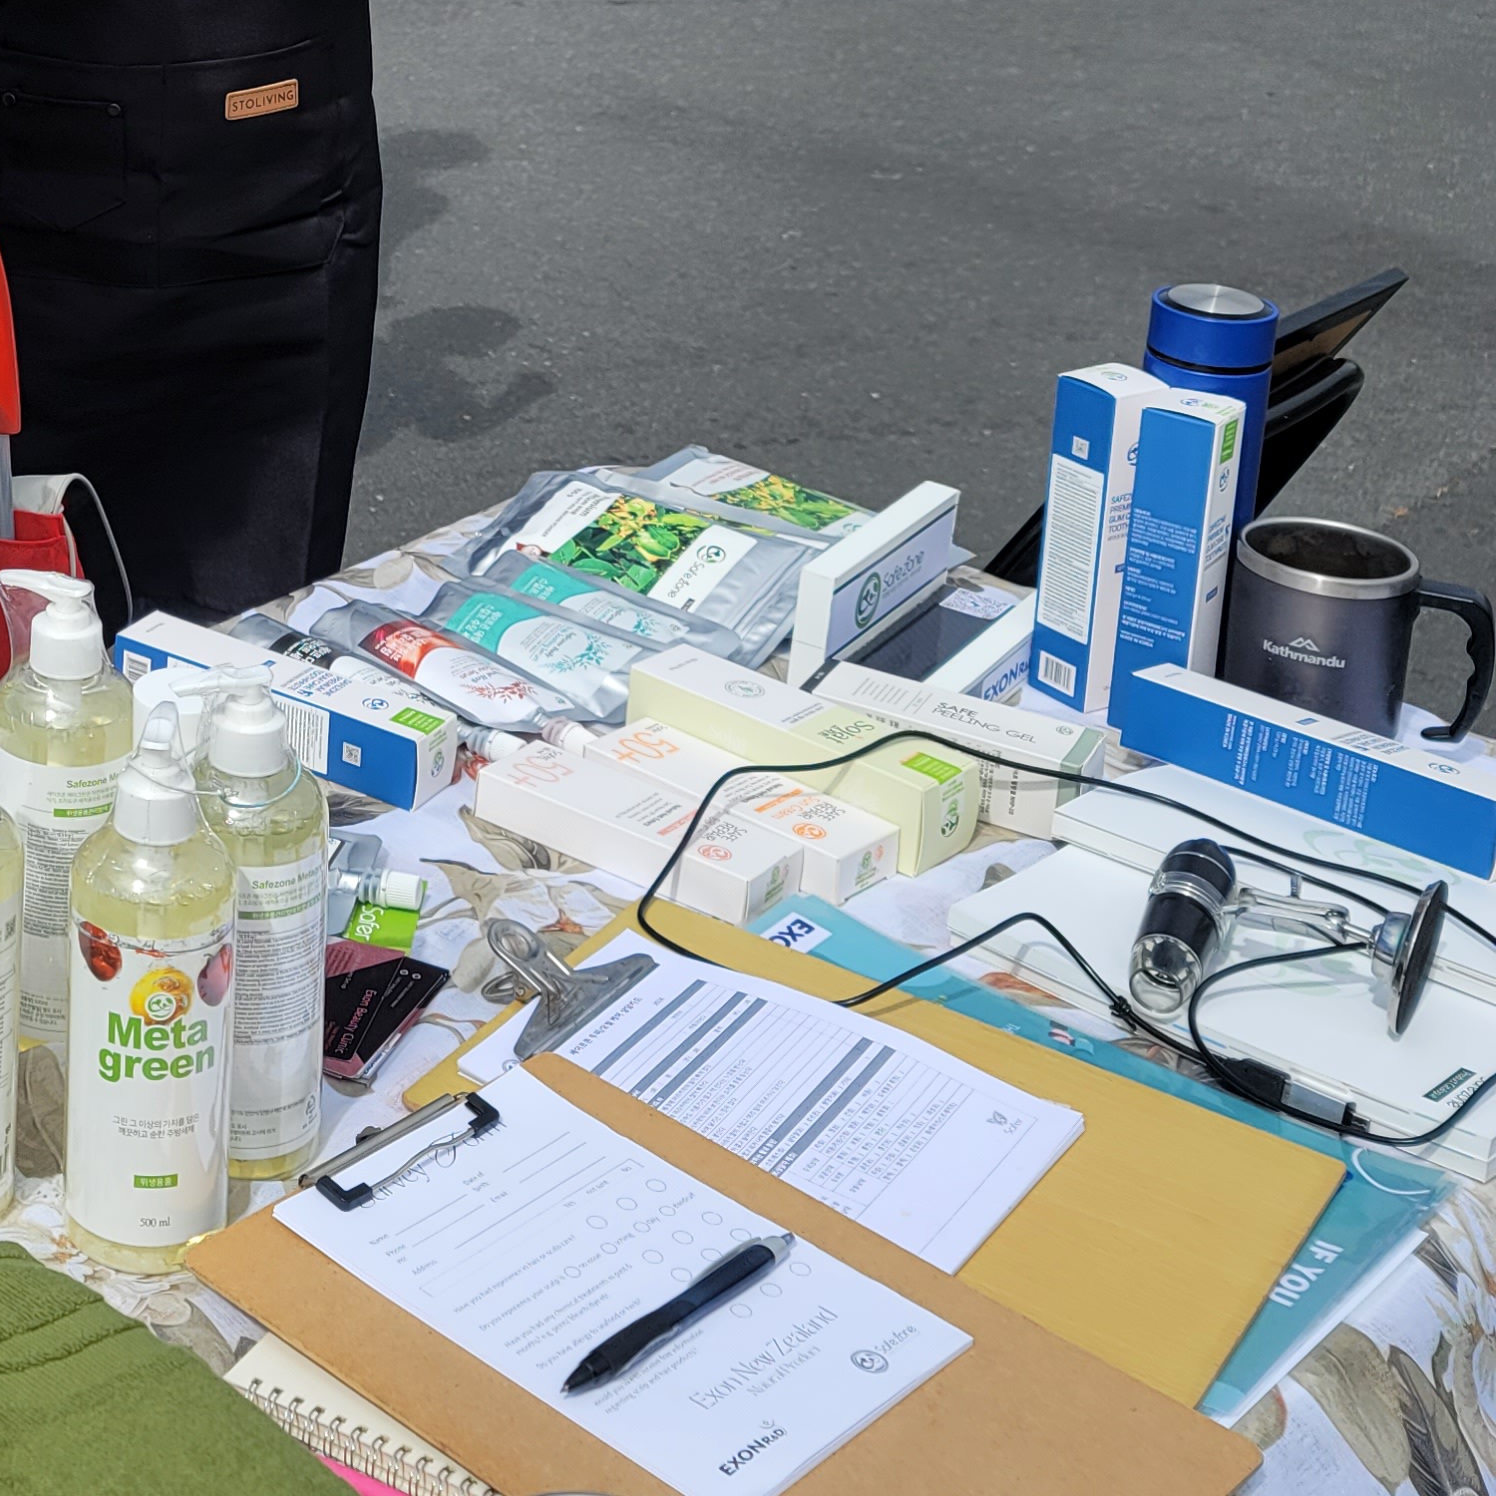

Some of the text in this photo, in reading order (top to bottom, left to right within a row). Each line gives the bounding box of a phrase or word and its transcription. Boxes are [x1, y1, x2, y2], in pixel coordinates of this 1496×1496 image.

[232, 90, 294, 112] STOLIVING
[1263, 639, 1346, 669] Kathmandu
[932, 707, 1037, 745] PEELING GEL
[936, 702, 978, 718] SAFE
[610, 730, 681, 763] 50+
[508, 752, 574, 788] 50+
[356, 905, 384, 941] Safer
[108, 1011, 209, 1052] Meta
[98, 1045, 215, 1083] green
[139, 1216, 171, 1228] 500 ml
[1268, 1239, 1345, 1308] IF YOU
[689, 1305, 839, 1411] Exon New Zealand
[718, 1438, 765, 1477] EXON
